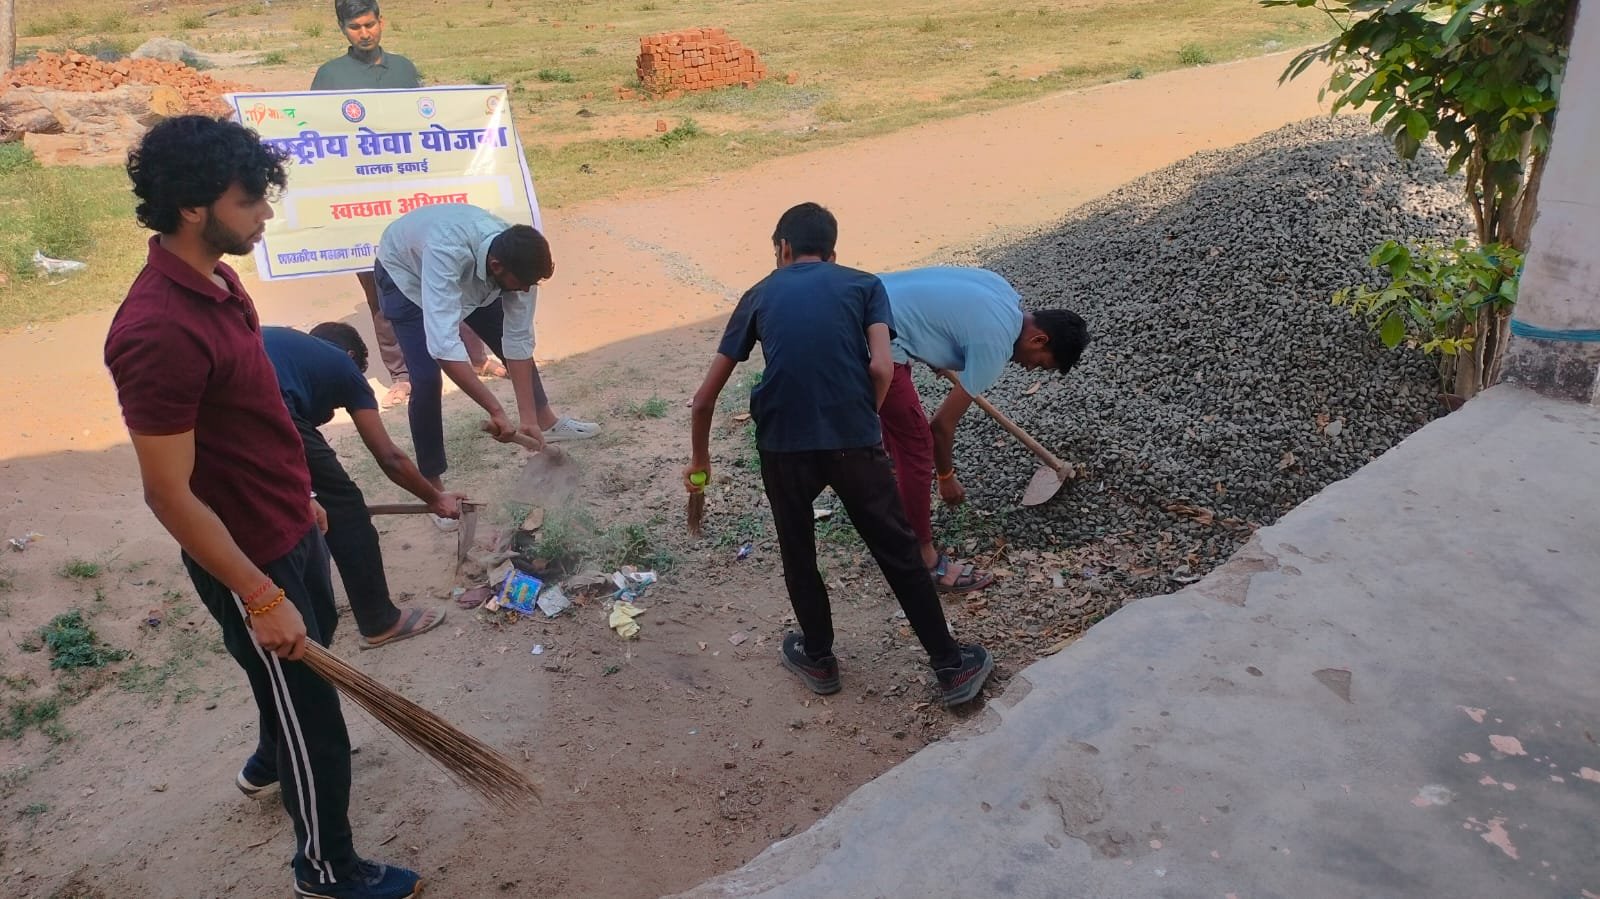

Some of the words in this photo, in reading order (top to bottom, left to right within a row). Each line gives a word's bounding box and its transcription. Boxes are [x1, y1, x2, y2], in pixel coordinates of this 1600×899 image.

[356, 127, 412, 156] सेवा
[355, 163, 393, 175] बालक
[396, 158, 429, 174] इकाई
[329, 200, 392, 219] स्वच्छता
